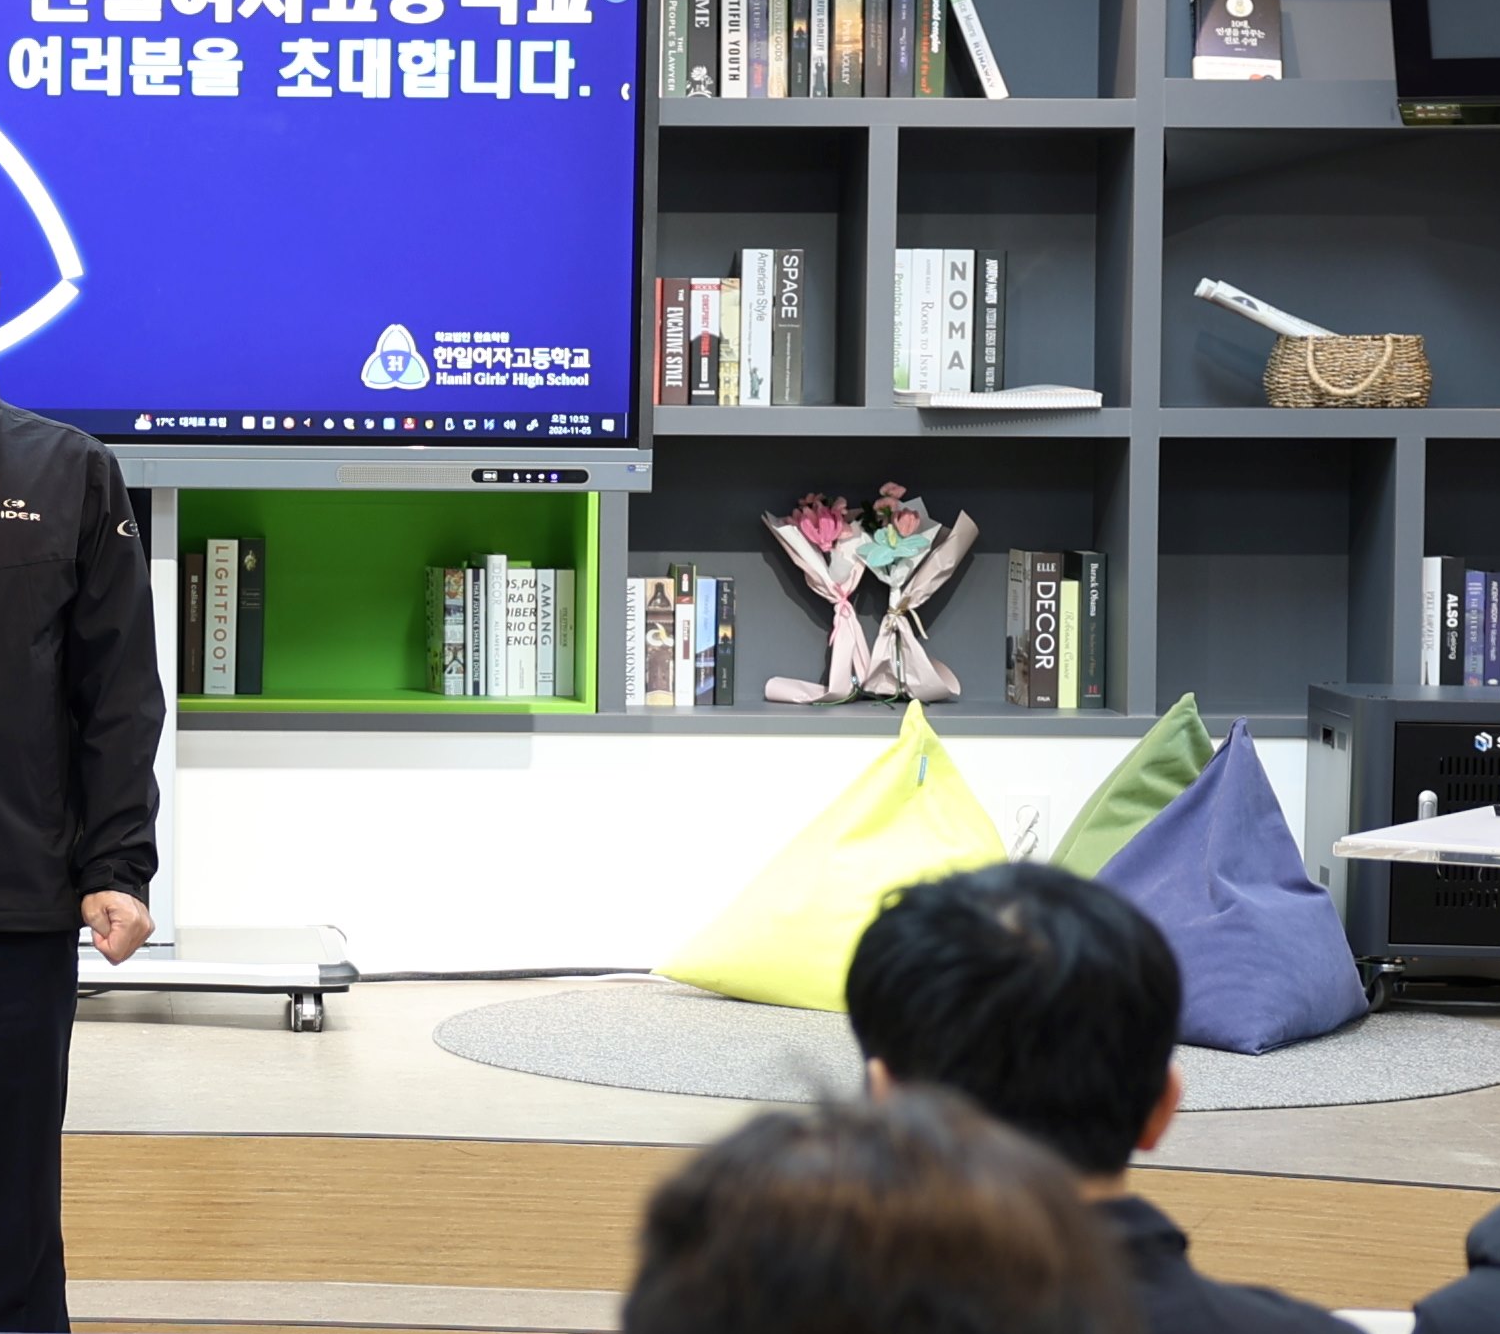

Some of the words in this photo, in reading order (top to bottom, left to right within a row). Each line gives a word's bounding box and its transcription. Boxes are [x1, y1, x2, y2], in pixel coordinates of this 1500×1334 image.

[668, 0, 677, 47] PEOPLE'S
[8, 35, 244, 98] 여러분을
[276, 38, 592, 100] 초대합니다.
[667, 49, 677, 91] LAWYER
[728, 39, 741, 82] YOUTH
[756, 251, 769, 297] American
[781, 254, 799, 319] SPACE
[754, 298, 768, 322] Style
[433, 346, 591, 371] 한일여자고등학교
[665, 355, 684, 388] STYLE
[435, 371, 471, 387] Hanil
[512, 371, 544, 389] High
[546, 371, 590, 387] School
[1037, 562, 1057, 572] ELLE
[1089, 562, 1099, 588] Barack
[212, 545, 229, 674] LIGHTFOOT
[540, 582, 552, 646] AMANG
[625, 585, 636, 643] MARILYN
[1089, 589, 1099, 617] Obama
[1445, 593, 1459, 628] ALSO
[1034, 580, 1056, 670] DECOR
